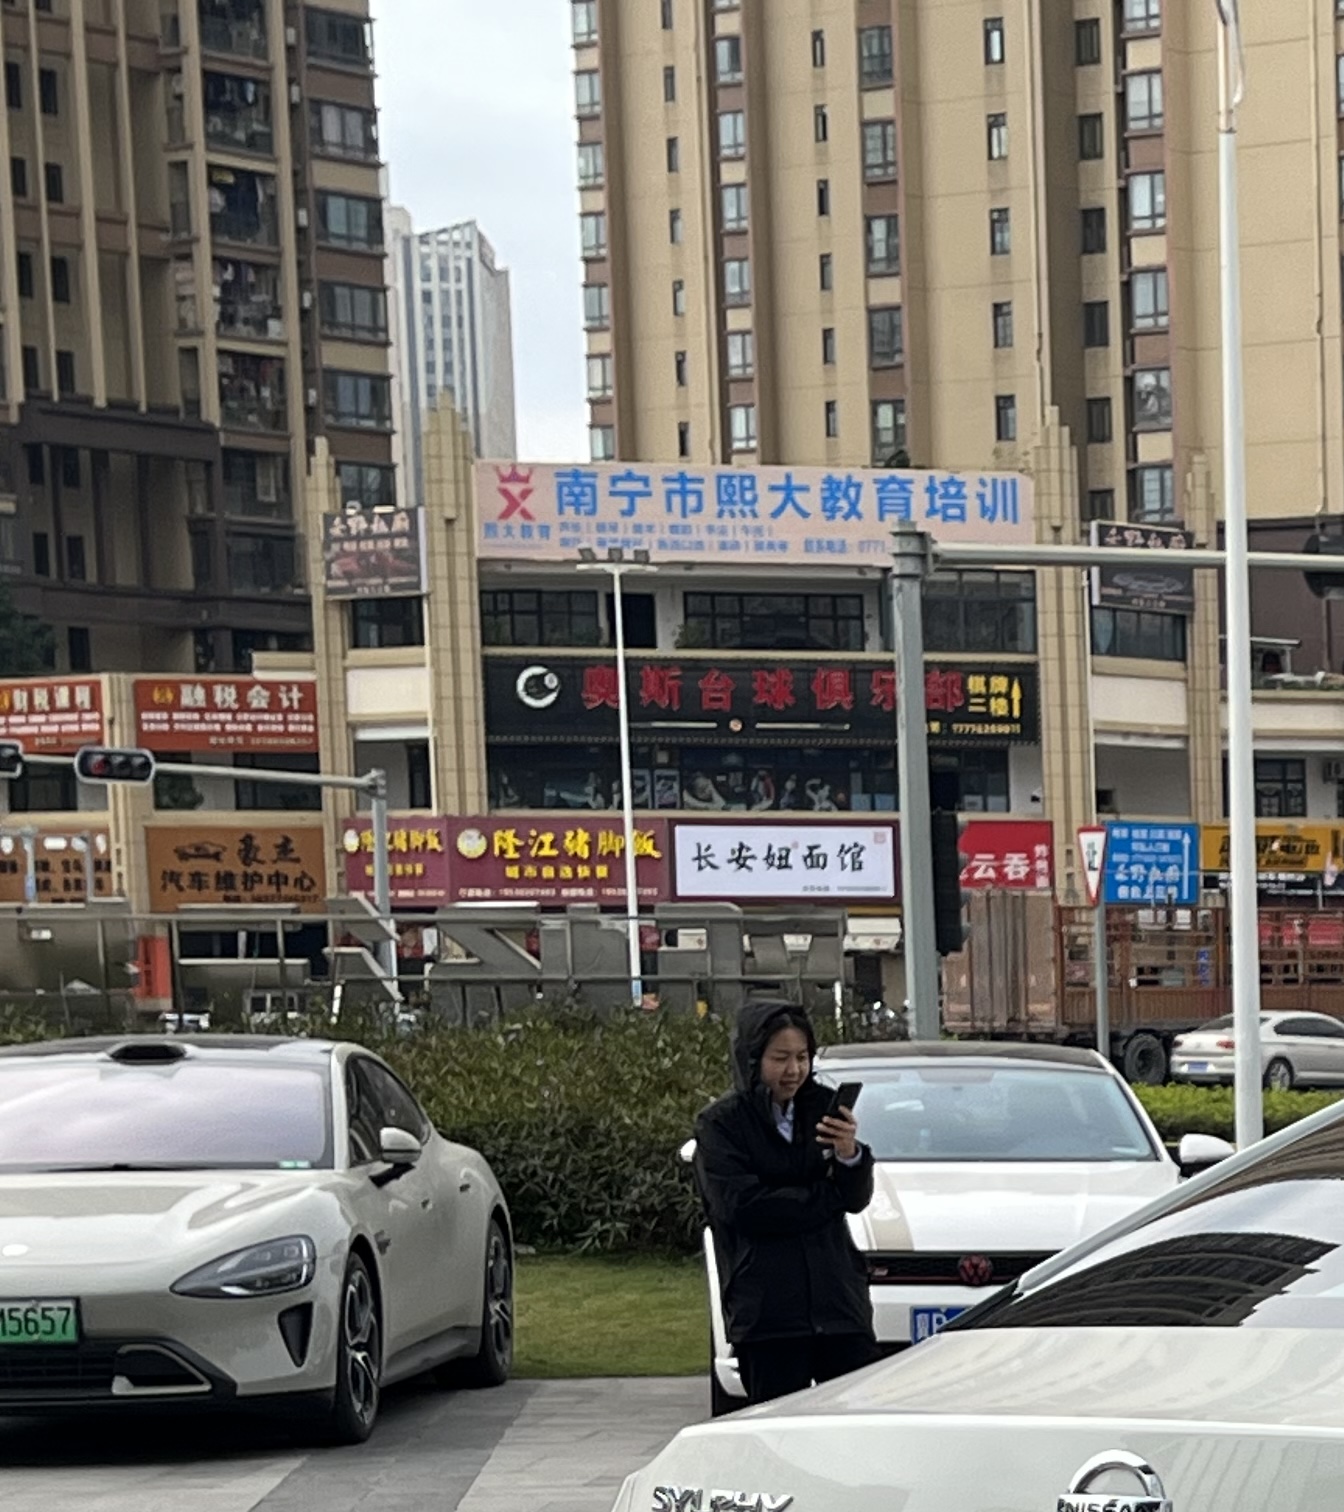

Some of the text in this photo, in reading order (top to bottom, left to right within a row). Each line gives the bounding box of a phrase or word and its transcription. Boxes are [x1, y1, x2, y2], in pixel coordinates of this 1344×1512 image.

[555, 468, 1020, 526] 南宁市熙大教育培训
[179, 684, 304, 710] 融税会计
[581, 664, 965, 713] 奥斯台球俱乐部
[493, 827, 663, 860] 隆江猪脚饭
[161, 869, 317, 893] 汽车维护中心
[959, 852, 1031, 881] 云吞
